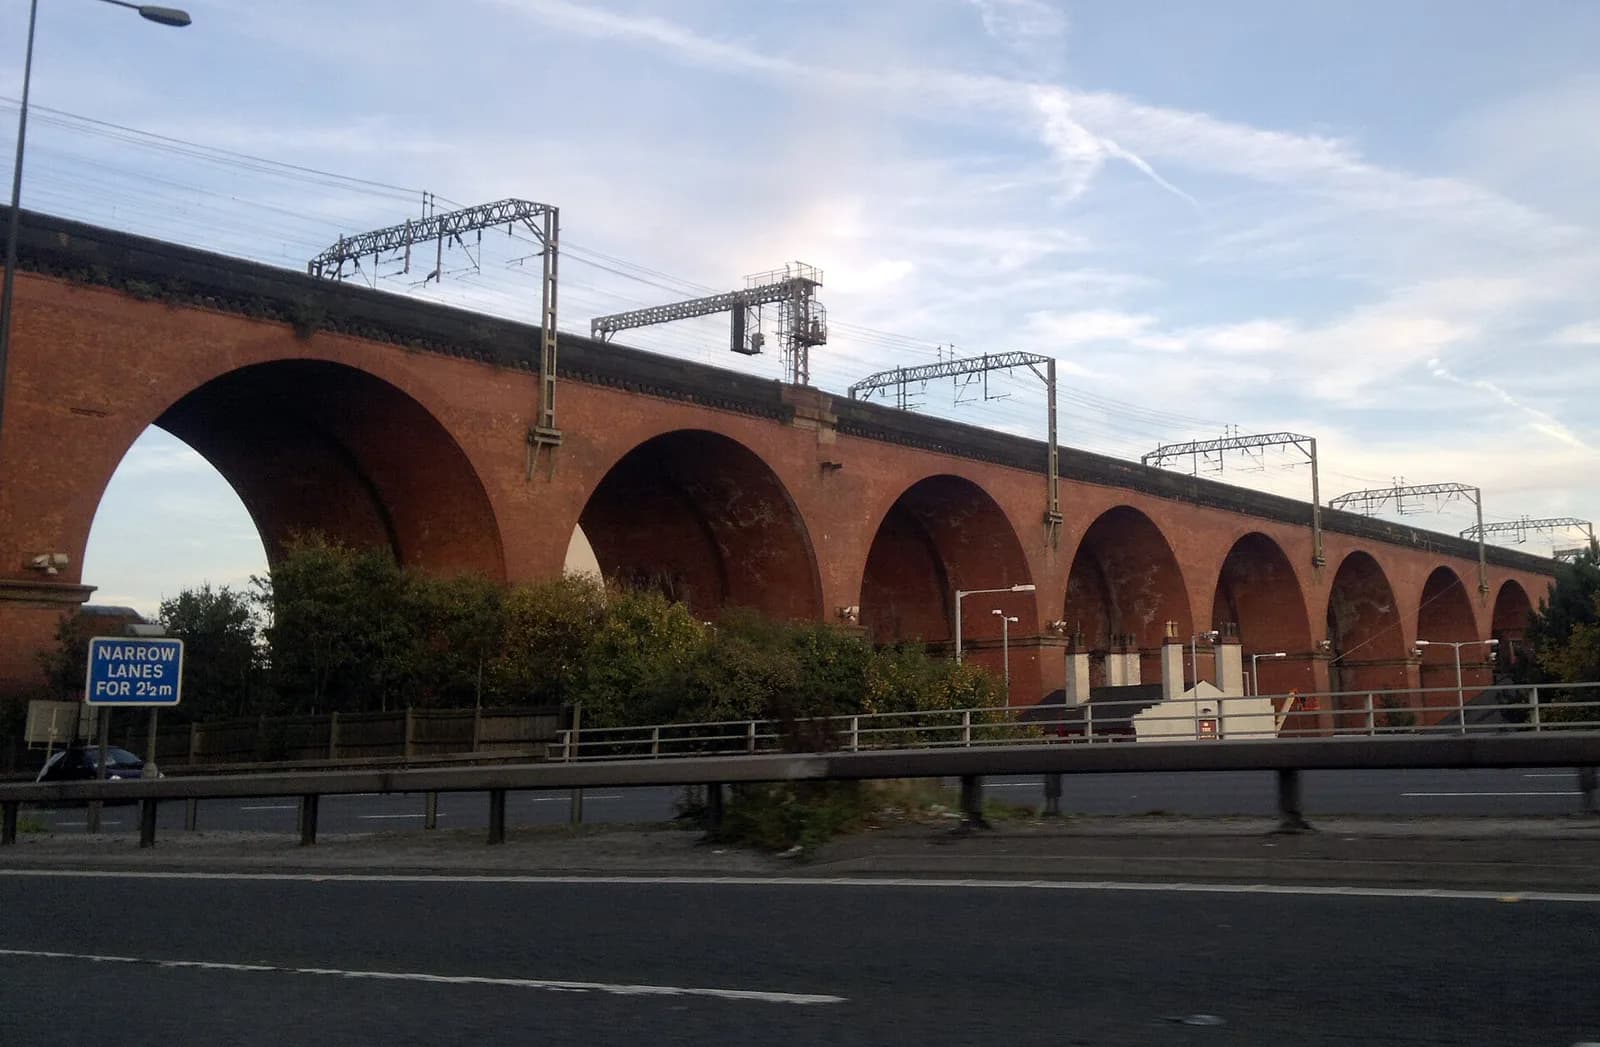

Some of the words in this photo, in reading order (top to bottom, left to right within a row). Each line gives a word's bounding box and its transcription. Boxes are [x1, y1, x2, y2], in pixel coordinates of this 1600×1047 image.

[98, 646, 175, 661] NARROW
[107, 664, 163, 678] LANES
[96, 681, 130, 696] FOR
